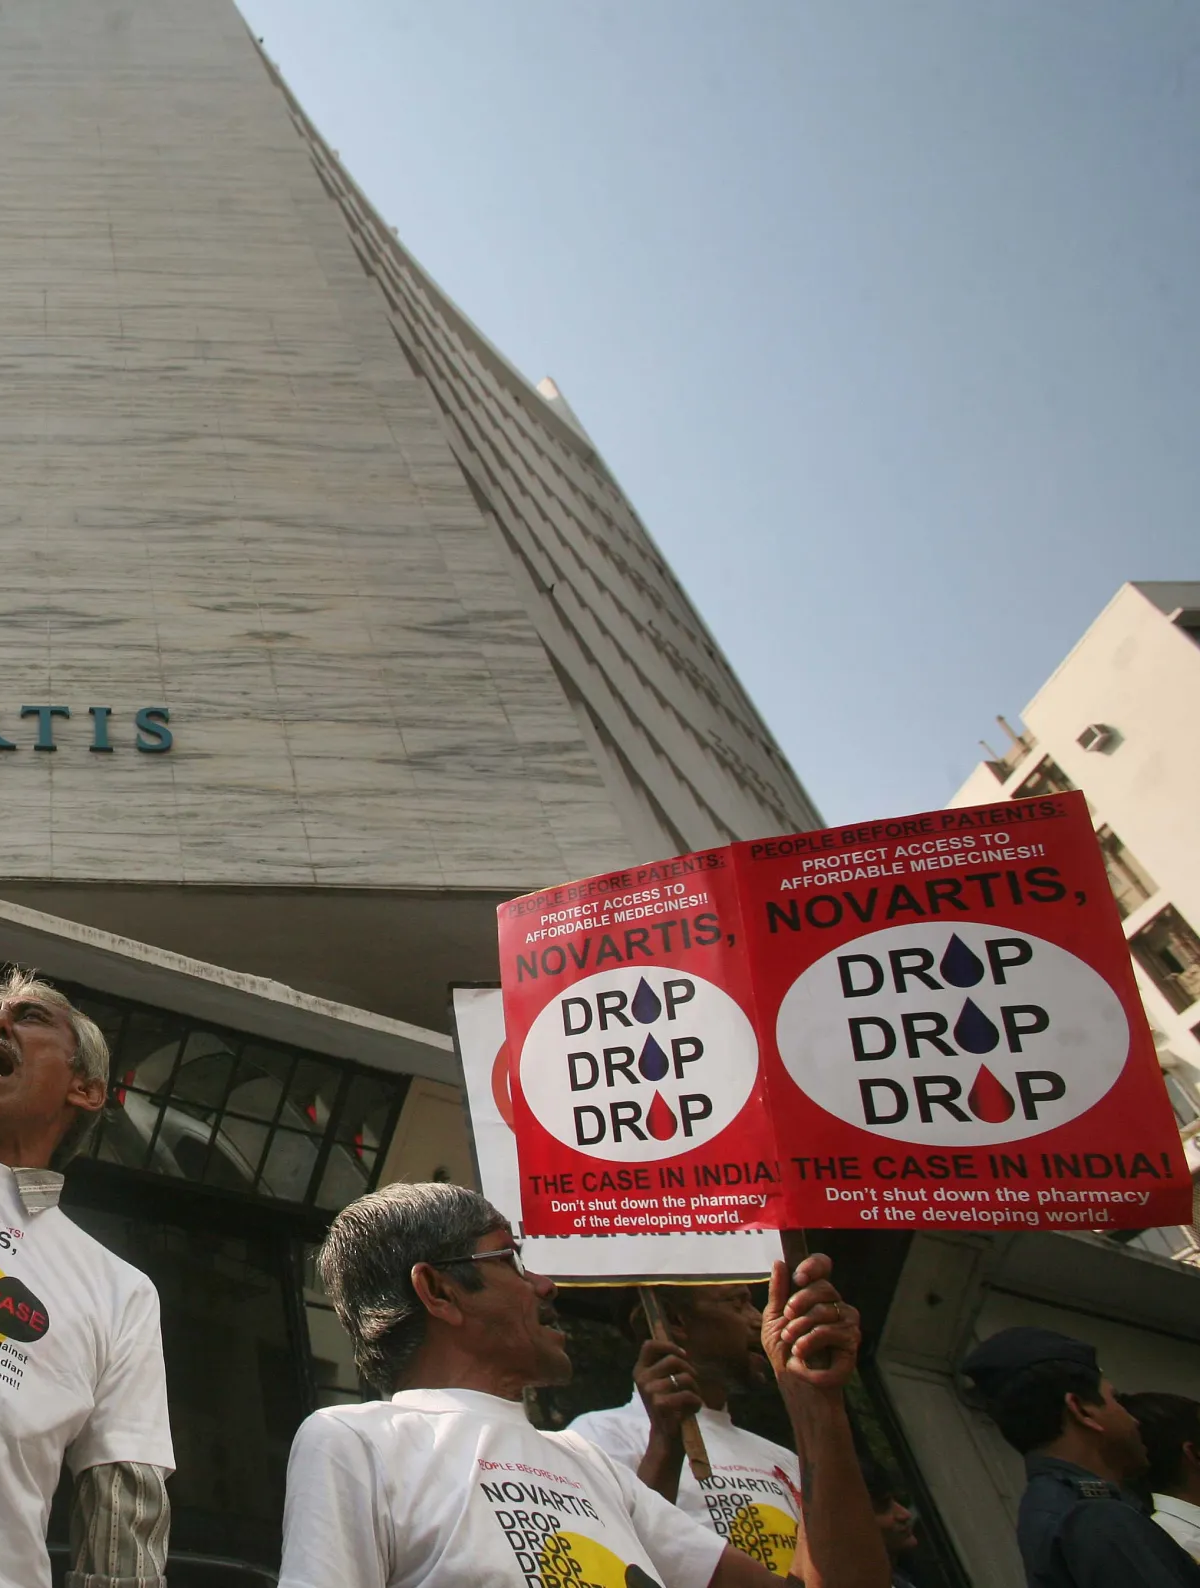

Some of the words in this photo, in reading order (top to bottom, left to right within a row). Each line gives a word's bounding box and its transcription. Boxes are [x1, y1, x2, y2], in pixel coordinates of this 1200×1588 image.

[751, 834, 833, 858] PEOPLE
[842, 817, 934, 844] BEFORE
[942, 800, 1066, 829] PATENTS:
[802, 847, 888, 872] PROTECT
[894, 835, 976, 858] ACCESS
[980, 832, 1010, 845] TO
[780, 861, 904, 891] AFFORDABLE
[910, 844, 1045, 872] MEDECINES!!
[509, 891, 562, 917] PEOPLE
[567, 873, 633, 900] BEFORE
[637, 854, 725, 884] PATENTS:
[766, 866, 1087, 933] NOVARTIS,
[525, 914, 610, 944] AFFORDABLE
[614, 892, 708, 923] MEDECINES!!
[540, 902, 599, 926] PROTECT
[603, 888, 661, 910] ACCESS
[664, 883, 685, 896] TO
[516, 913, 735, 982] NOVARTIS,
[529, 1174, 575, 1196] THE
[582, 1169, 649, 1192] CASE
[659, 1166, 686, 1188] IN
[695, 1160, 781, 1187] INDIA!
[791, 1156, 860, 1181] THE
[873, 1154, 977, 1180] CASE
[990, 1154, 1028, 1179] IN
[1041, 1152, 1173, 1179] INDIA!
[551, 1200, 585, 1213] Don't
[588, 1198, 617, 1211] shut
[620, 1197, 659, 1210] down
[662, 1195, 686, 1208] the
[690, 1192, 767, 1211] pharmacy
[825, 1187, 877, 1202] Don't
[882, 1187, 928, 1202] shut
[933, 1188, 990, 1203] down
[995, 1188, 1030, 1203] the
[1038, 1188, 1150, 1206] pharmacy
[573, 1215, 587, 1228] of
[589, 1214, 610, 1227] the
[613, 1212, 692, 1231] developing
[695, 1210, 744, 1225] world.
[860, 1207, 878, 1221] of
[885, 1207, 916, 1221] the
[922, 1207, 1039, 1226] developing
[1045, 1208, 1115, 1223] world.
[705, 1493, 752, 1508] DROP
[709, 1506, 759, 1521] DROP
[494, 1509, 561, 1535] DROP
[714, 1520, 764, 1535] DROP
[504, 1530, 572, 1557] DROP
[514, 1551, 583, 1580] DROP
